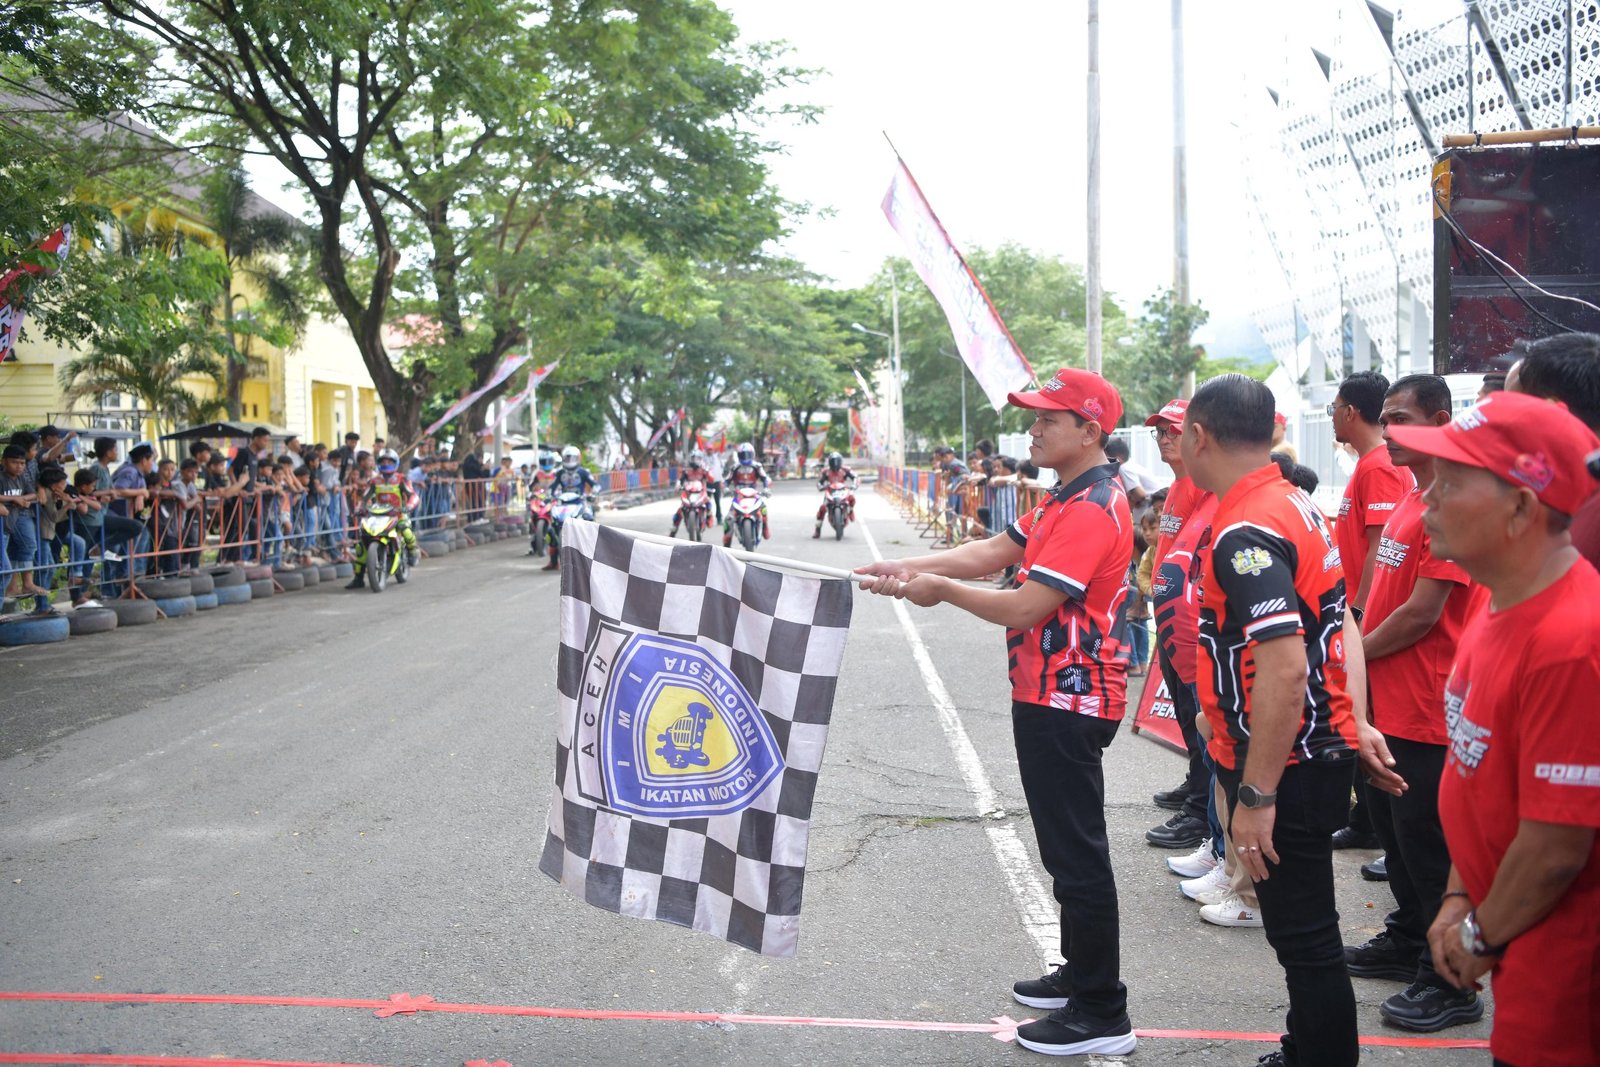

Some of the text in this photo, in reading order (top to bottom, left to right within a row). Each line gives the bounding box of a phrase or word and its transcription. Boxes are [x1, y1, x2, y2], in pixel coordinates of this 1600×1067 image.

[581, 655, 607, 758] ACEH
[617, 672, 643, 767] IMI
[663, 656, 759, 747] INDONESIA
[1150, 701, 1177, 719] PEM
[640, 767, 757, 803] IKATAN MOTOR
